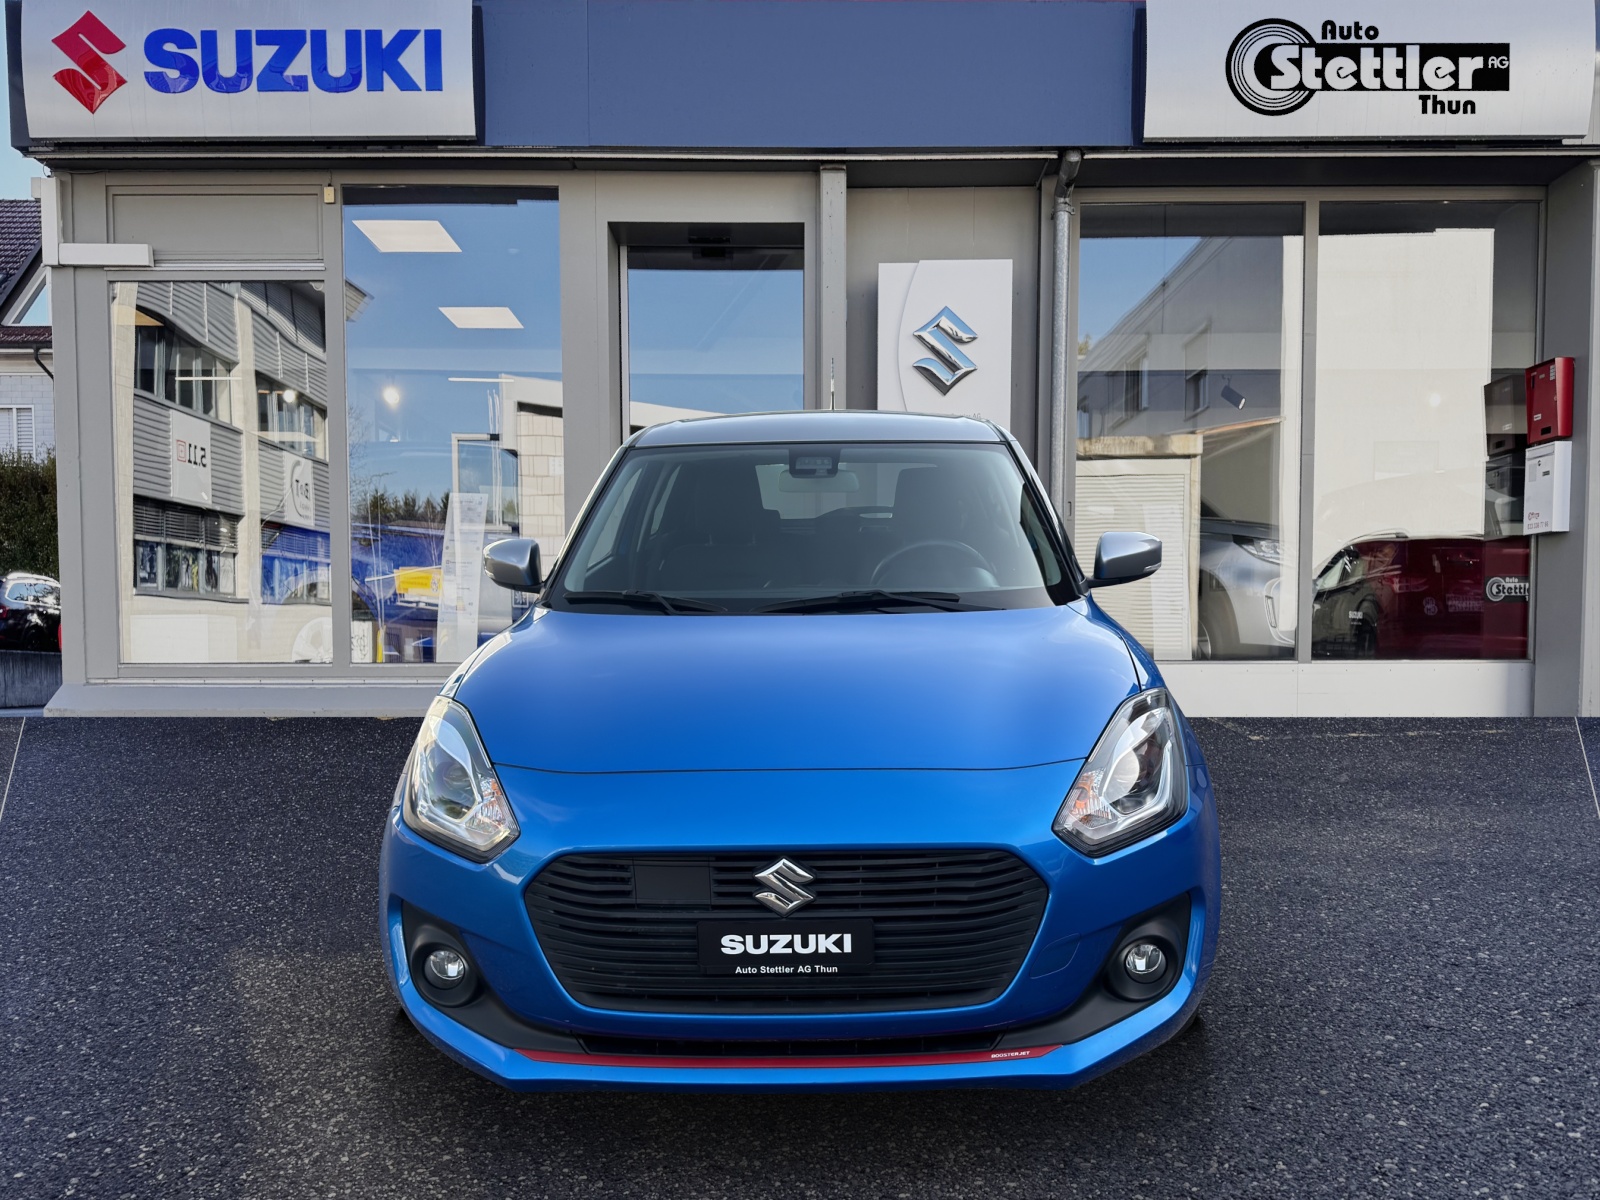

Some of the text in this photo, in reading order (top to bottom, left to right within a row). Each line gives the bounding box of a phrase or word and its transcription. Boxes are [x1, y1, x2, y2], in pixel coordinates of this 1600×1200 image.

[1321, 19, 1380, 41] Auto
[143, 28, 444, 94] SUZUKI
[1270, 44, 1509, 90] Stettler AG
[1418, 94, 1476, 115] Thun
[1495, 583, 1529, 596] Stettl
[720, 933, 852, 955] SUZUKI
[735, 965, 838, 974] Auto Stettler AG Thun
[991, 1050, 1031, 1058] BOOSTERJET
